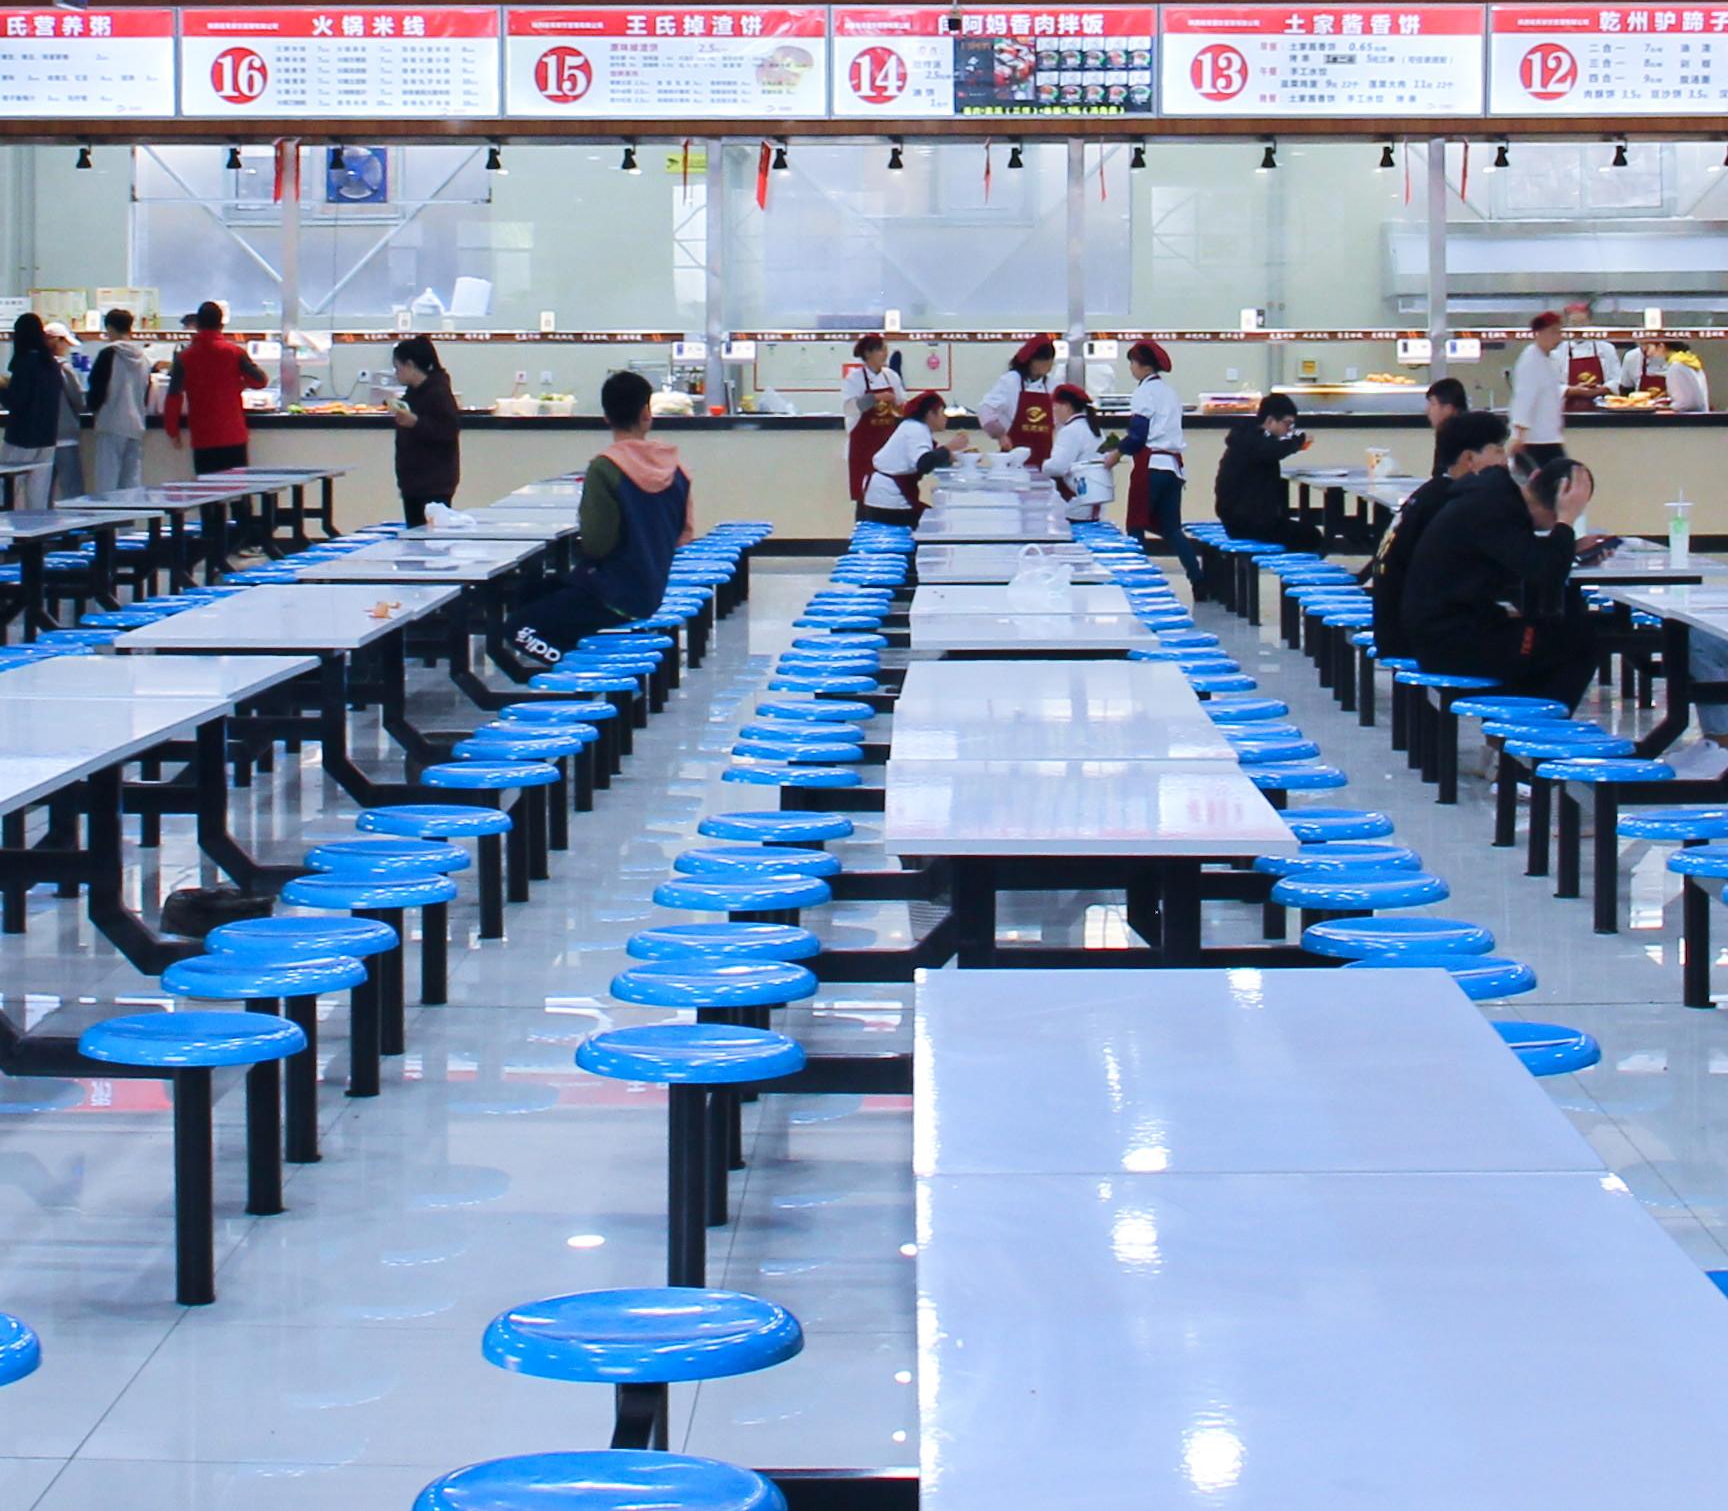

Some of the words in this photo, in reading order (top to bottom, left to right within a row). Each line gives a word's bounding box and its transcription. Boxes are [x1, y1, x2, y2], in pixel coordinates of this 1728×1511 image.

[312, 15, 426, 36] 火锅米线
[625, 15, 763, 35] 王氏掉渣饼
[1284, 13, 1421, 35] 土家酱香饼
[216, 55, 265, 97] 16
[542, 55, 588, 97] 15
[854, 55, 902, 97] 14
[1197, 52, 1243, 94] 13
[1526, 51, 1572, 91] 12
